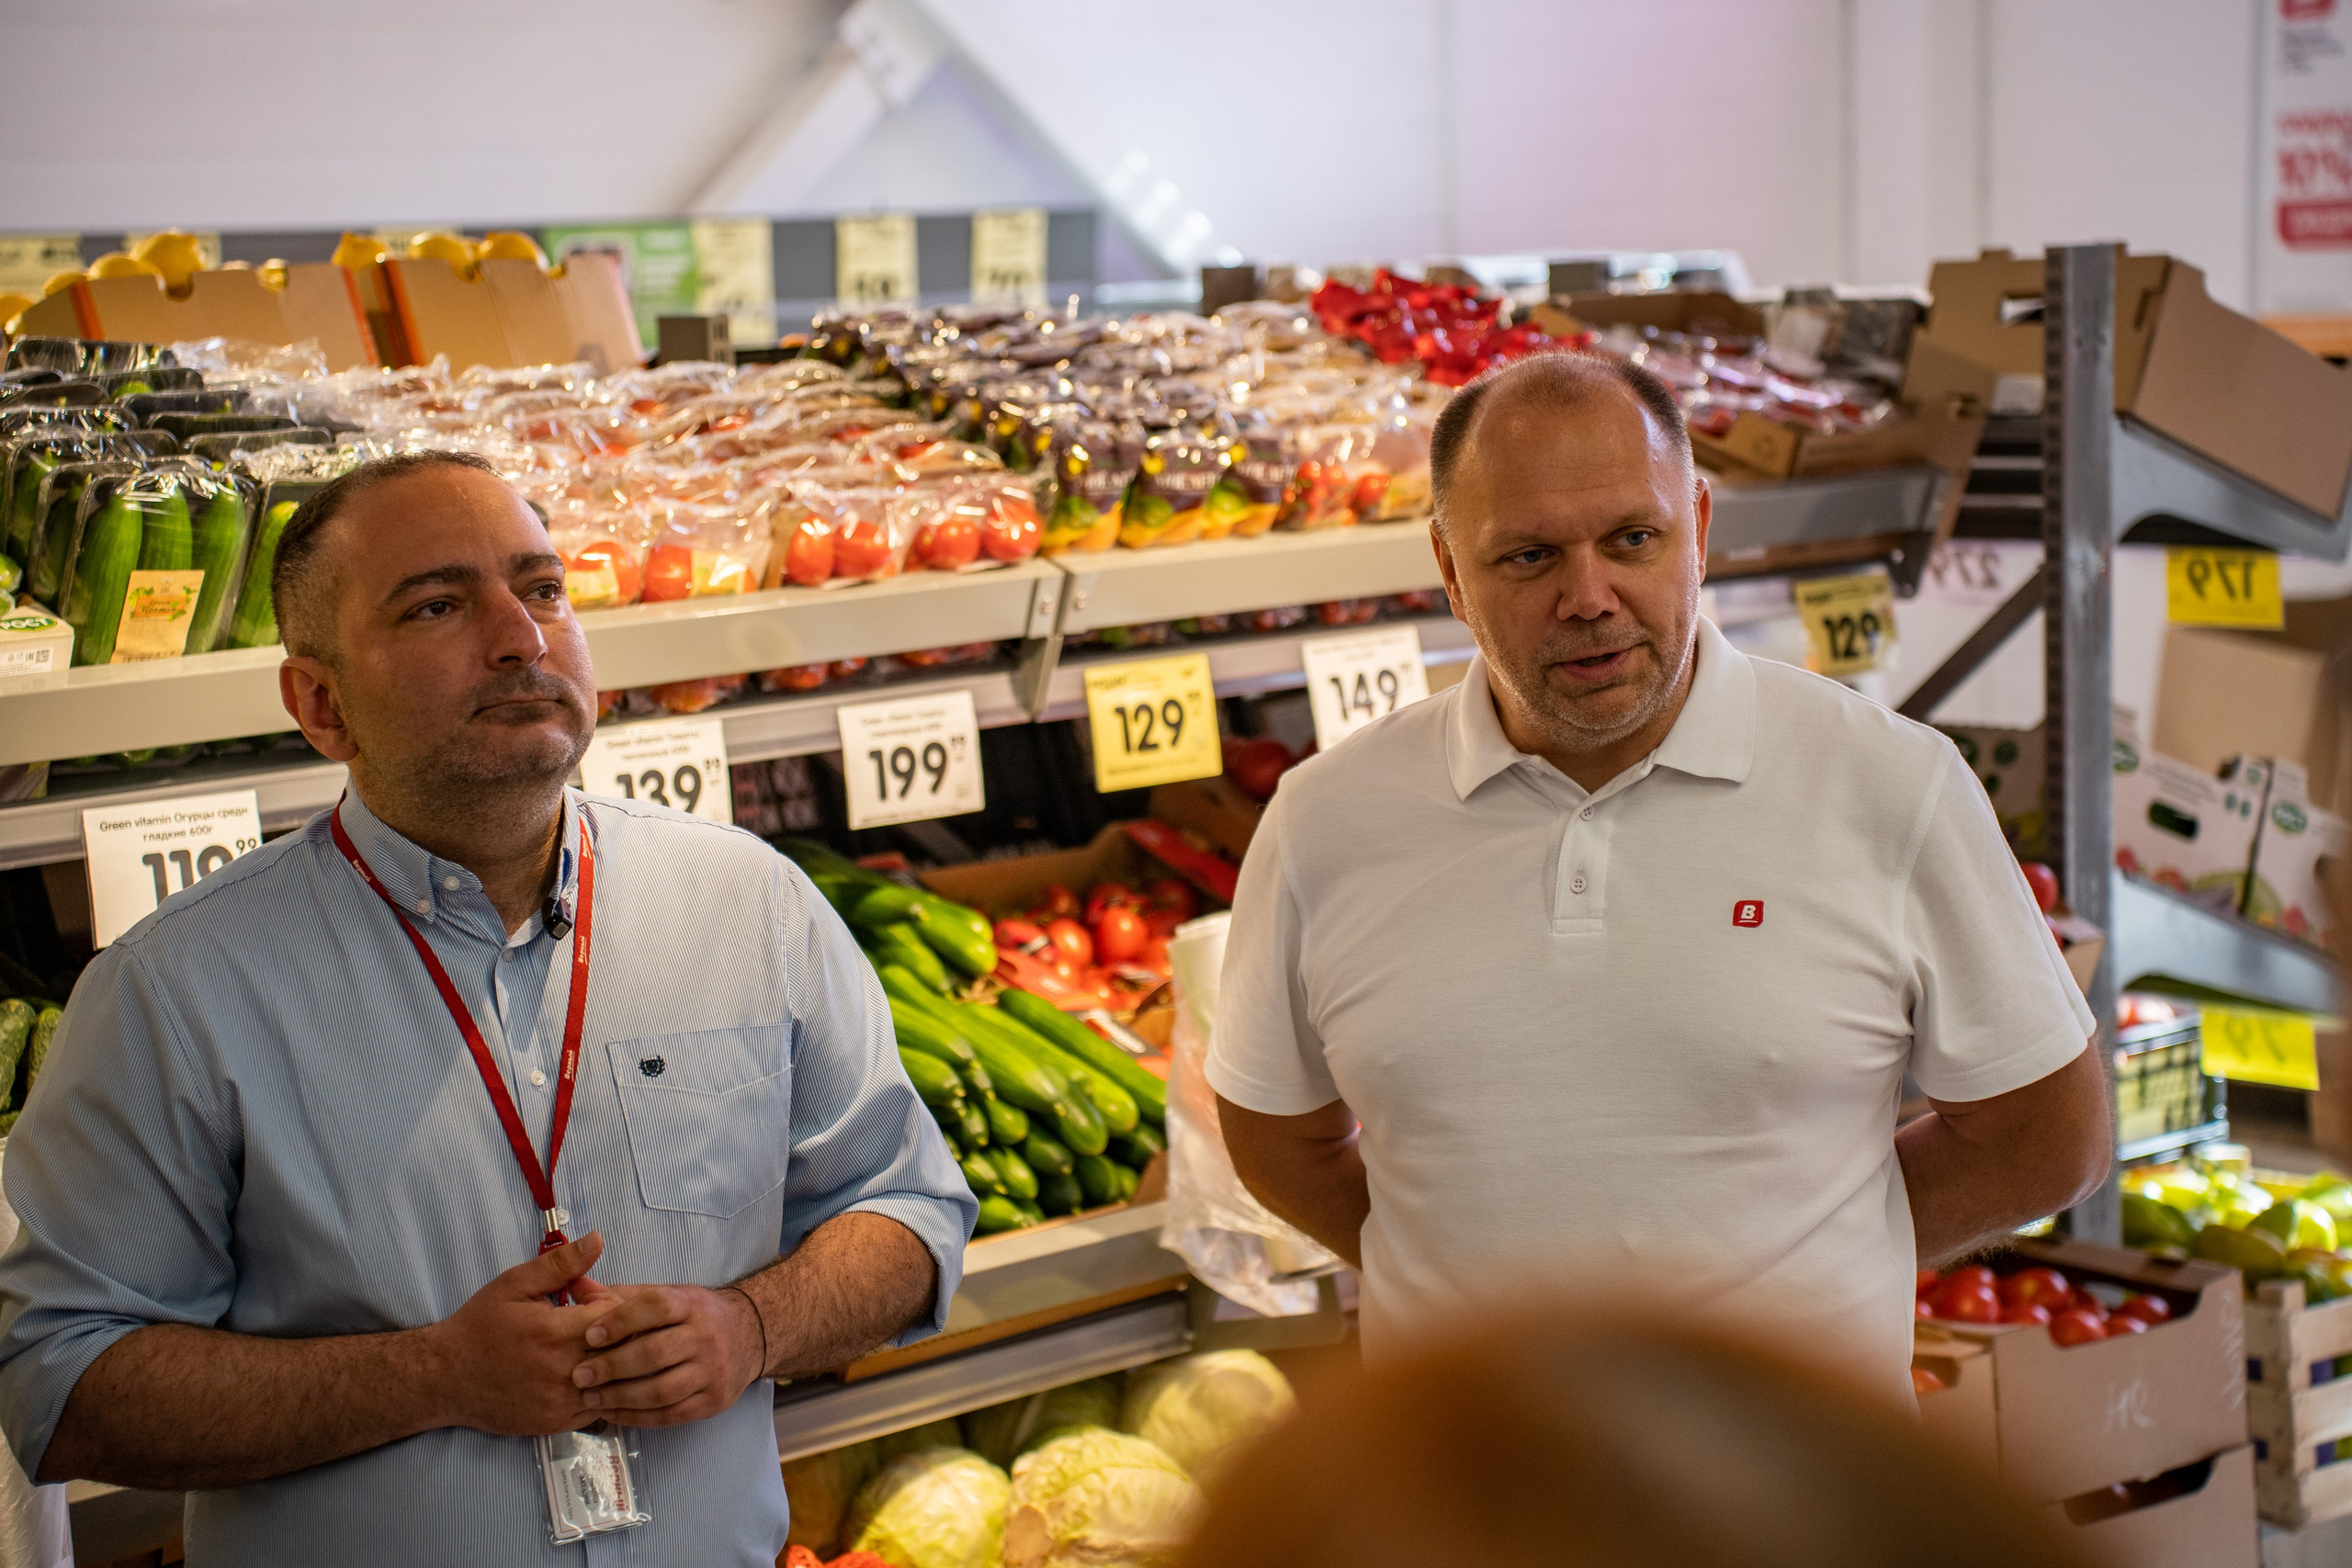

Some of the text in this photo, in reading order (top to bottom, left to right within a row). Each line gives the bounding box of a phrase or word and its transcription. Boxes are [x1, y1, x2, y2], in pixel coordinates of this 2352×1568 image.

[1823, 610, 1882, 660] 129
[1329, 669, 1399, 722] 149
[1114, 698, 1185, 754] 129
[868, 742, 947, 802] 199
[99, 807, 249, 832] Green vitamin Огурцы средн
[143, 825, 213, 842] гладкие 600г
[577, 935, 586, 964] Верный
[563, 1049, 574, 1080] Верный
